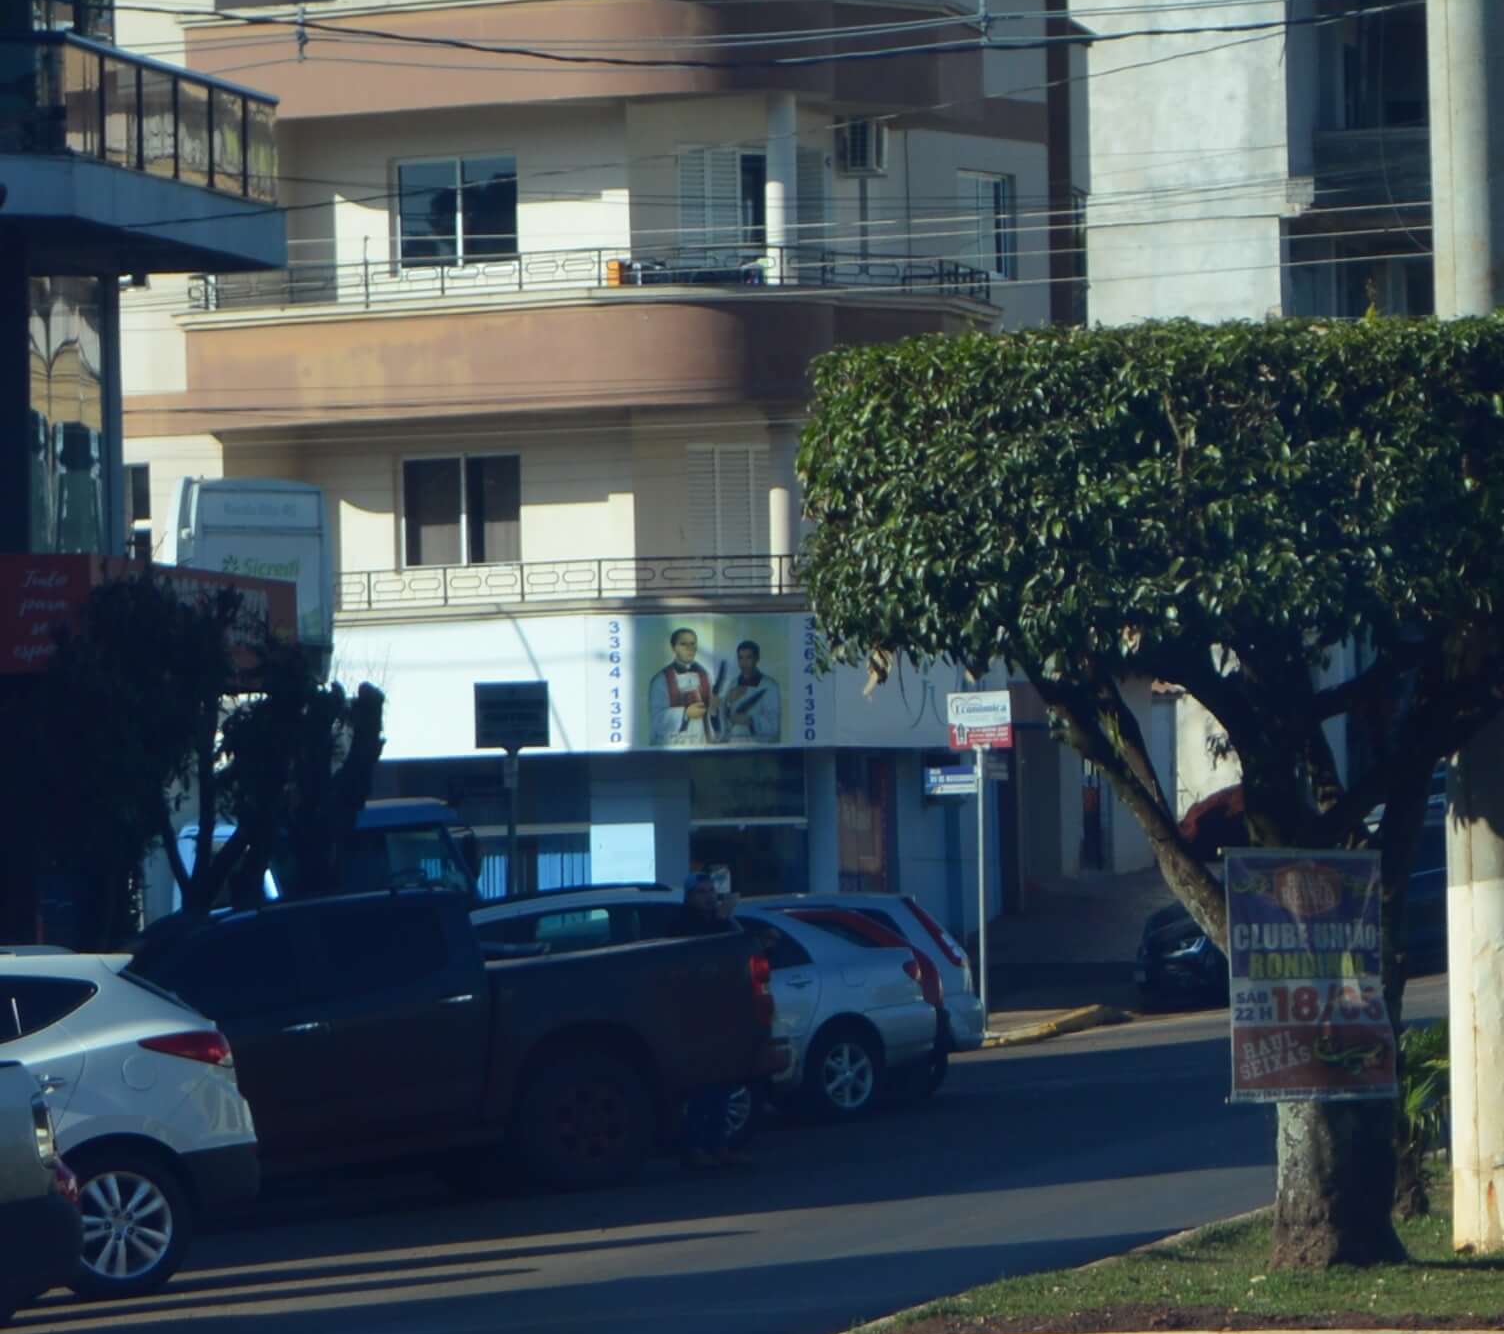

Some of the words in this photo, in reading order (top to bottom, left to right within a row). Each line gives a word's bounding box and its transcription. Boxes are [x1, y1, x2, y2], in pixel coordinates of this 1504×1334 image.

[1232, 922, 1309, 951] CLUBE
[1312, 918, 1377, 950] UNIÃO
[1243, 1030, 1299, 1061] RAUL
[1241, 1045, 1312, 1081] SEIXAS
